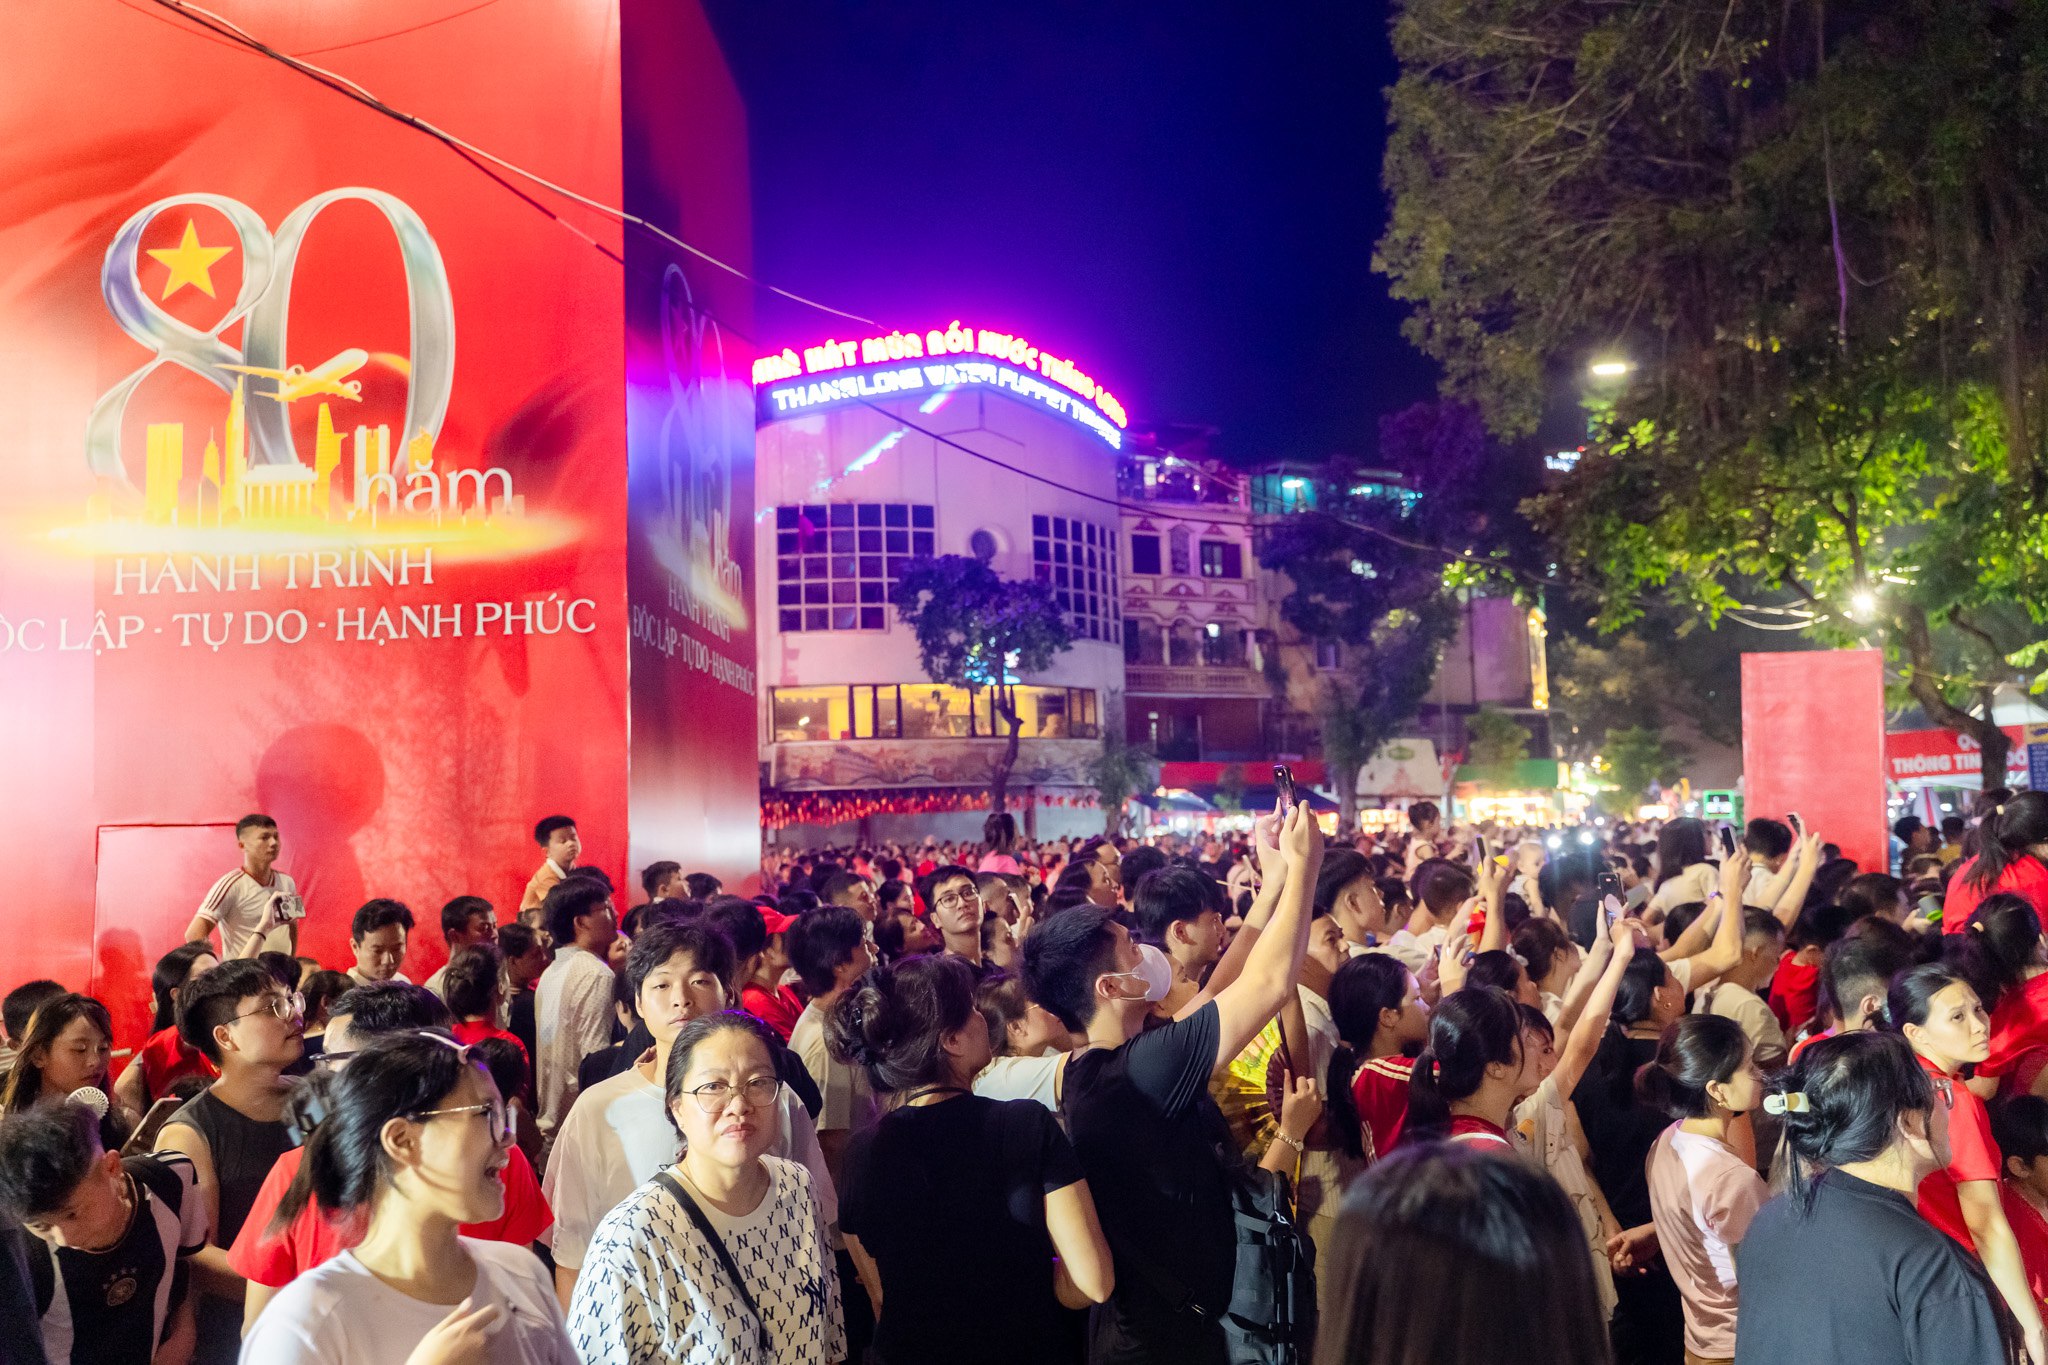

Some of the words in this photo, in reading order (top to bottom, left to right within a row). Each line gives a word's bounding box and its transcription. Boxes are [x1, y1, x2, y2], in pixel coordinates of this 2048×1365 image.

[857, 367, 923, 396] LONG
[357, 459, 513, 514] năm
[58, 609, 145, 656] LẬP
[172, 612, 234, 652] TỰ
[243, 608, 308, 645] DO
[336, 603, 462, 646] HẠNH
[474, 592, 597, 636] PHÚC
[1892, 754, 1951, 774] THÔNG
